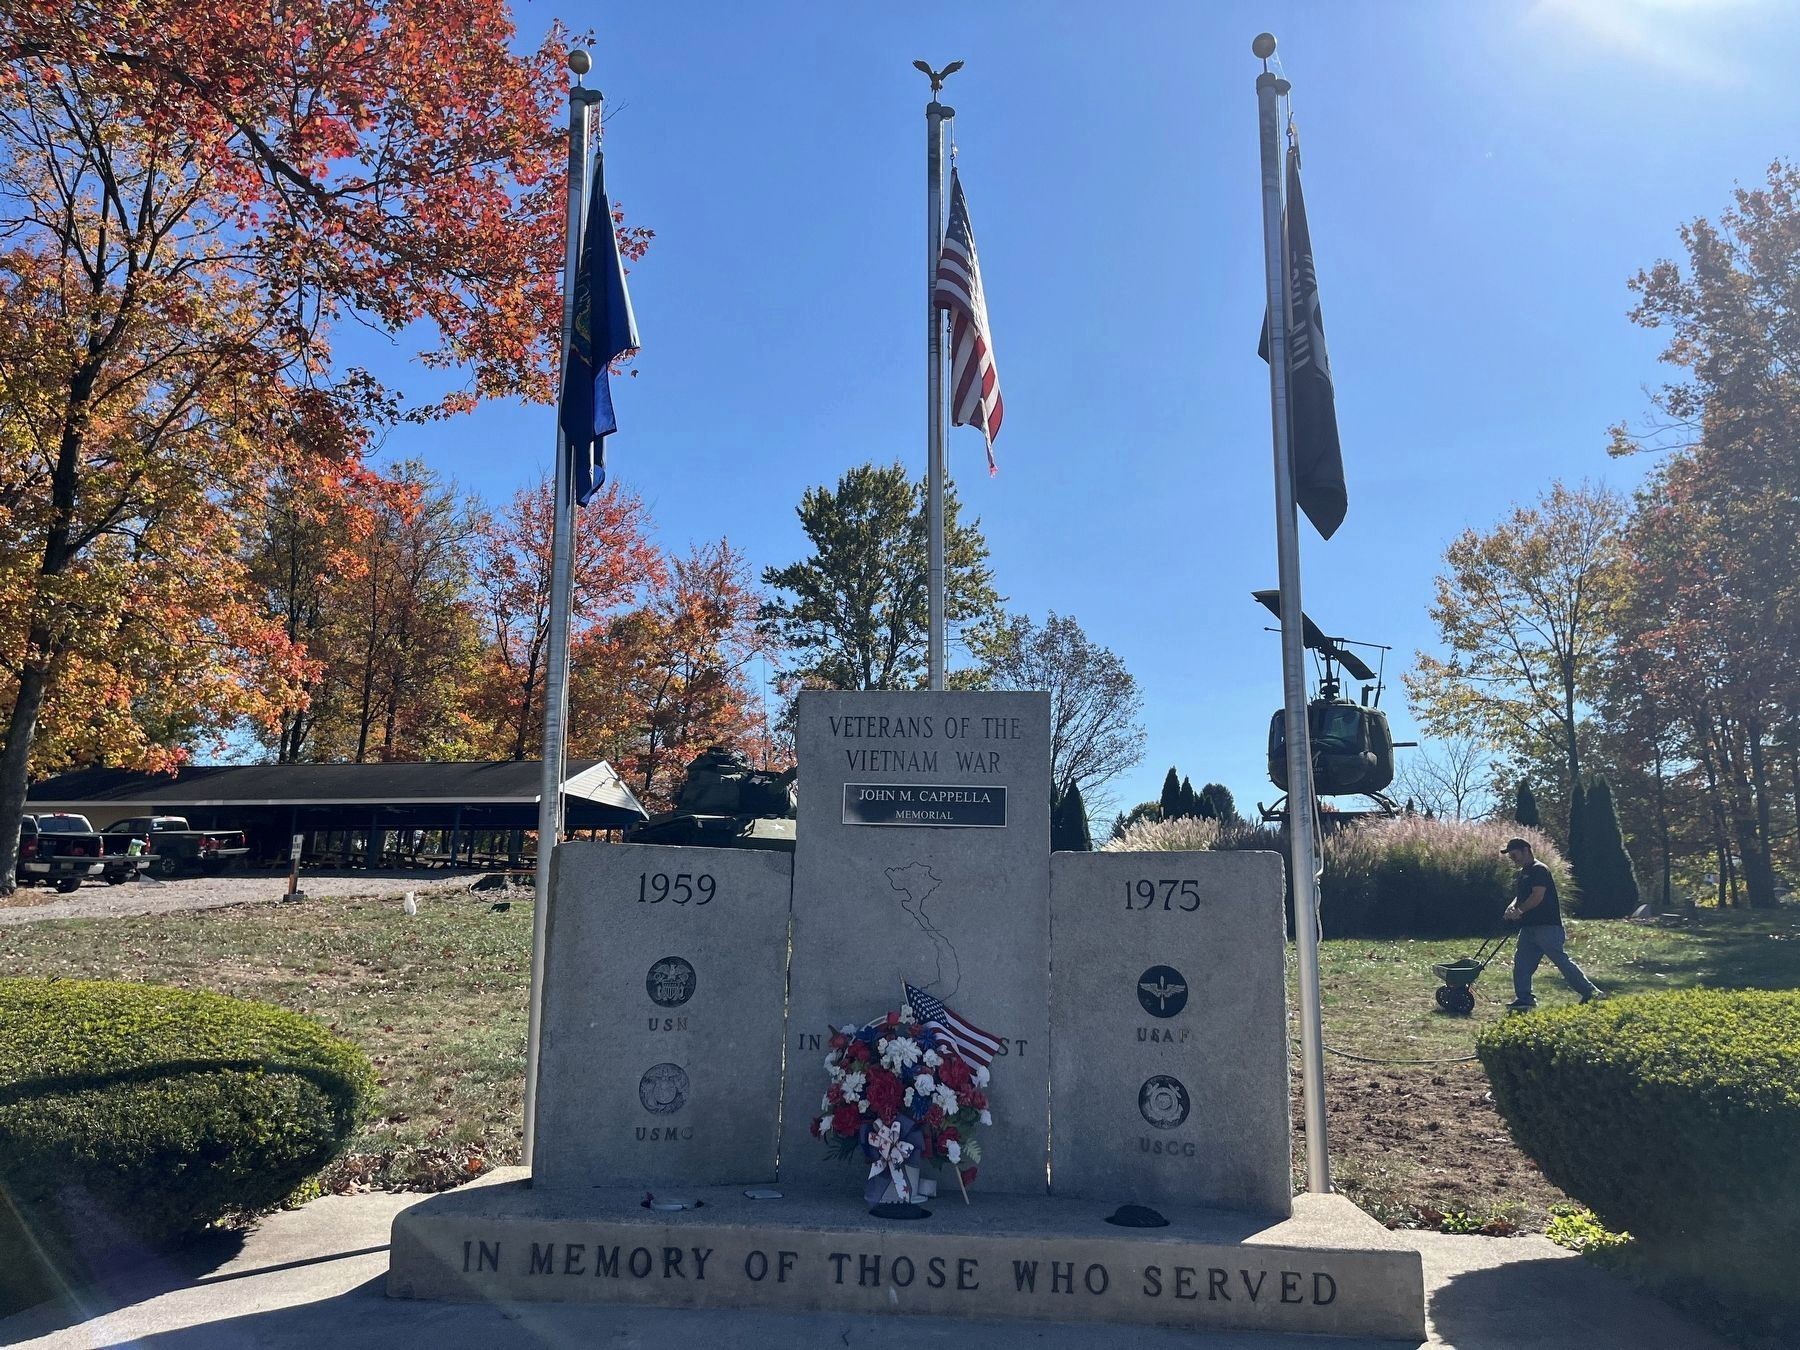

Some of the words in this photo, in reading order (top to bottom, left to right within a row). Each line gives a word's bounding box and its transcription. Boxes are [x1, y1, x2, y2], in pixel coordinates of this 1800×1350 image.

[829, 716, 934, 739] VETERANS
[945, 717, 969, 740] OF
[982, 717, 1021, 740] THE
[845, 749, 938, 773] VIETNAM
[956, 751, 1001, 774] WAR
[859, 789, 896, 802] JOHN
[899, 791, 915, 802] M.
[919, 791, 992, 804] CAPPELLA
[895, 810, 954, 821] MEMORIAL
[637, 872, 717, 906] 1959
[1125, 879, 1201, 912] 1975
[648, 1016, 690, 1032] USN
[798, 1034, 822, 1051] IN
[1137, 1027, 1190, 1043] USAF
[635, 1126, 694, 1142] USMC
[1139, 1139, 1196, 1157] USCG
[462, 1240, 502, 1273] IN
[529, 1243, 714, 1280] MEMORY
[745, 1250, 799, 1283] OF
[828, 1252, 980, 1291] THOSE
[1013, 1259, 1110, 1296] WHO
[1143, 1265, 1338, 1306] SERVED
